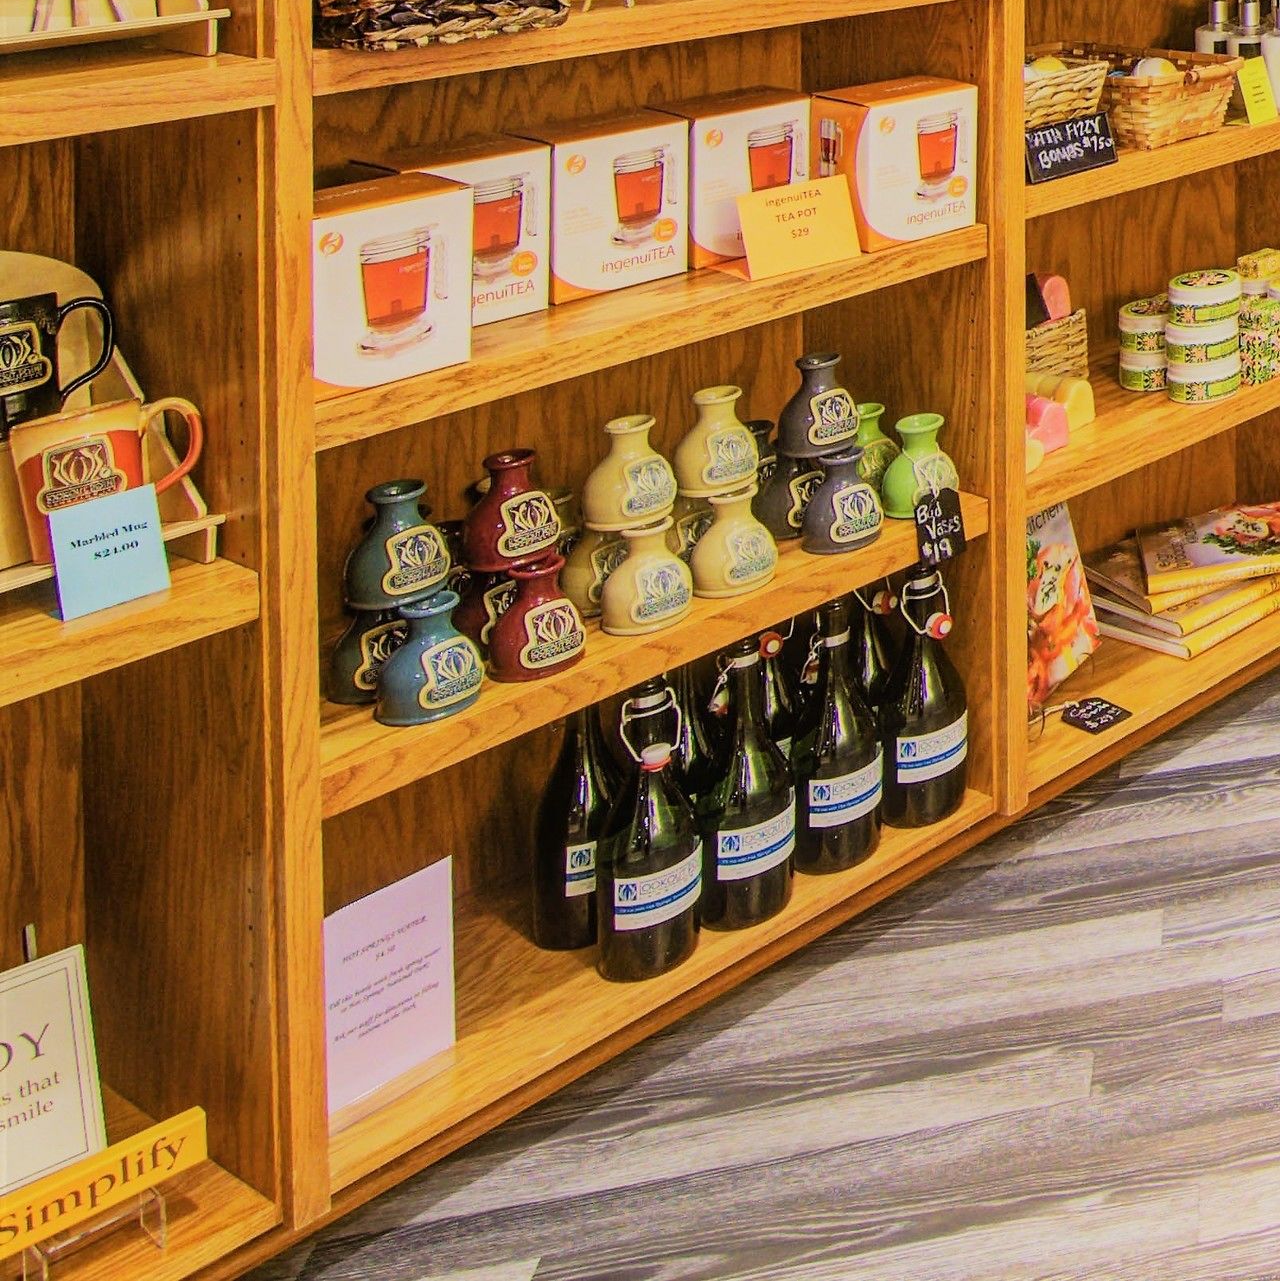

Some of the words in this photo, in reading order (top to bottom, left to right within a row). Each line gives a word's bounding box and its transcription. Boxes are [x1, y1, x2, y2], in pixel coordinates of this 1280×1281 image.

[1065, 115, 1101, 141] FIZZY
[1038, 142, 1084, 170] BOMBS
[765, 188, 822, 208] ingenuiTEA
[775, 212, 797, 225] TEA
[797, 207, 818, 220] POT
[906, 200, 967, 226] ingenuiTEA
[790, 227, 811, 240] $29
[601, 243, 677, 274] ingenuiTEA
[916, 503, 942, 523] Bud
[69, 528, 121, 551] Marbled
[120, 520, 149, 535] Mug
[92, 540, 140, 561] $24.00
[921, 539, 953, 561] $19
[19, 1071, 62, 1100] that
[0, 1134, 188, 1247] Simplify
